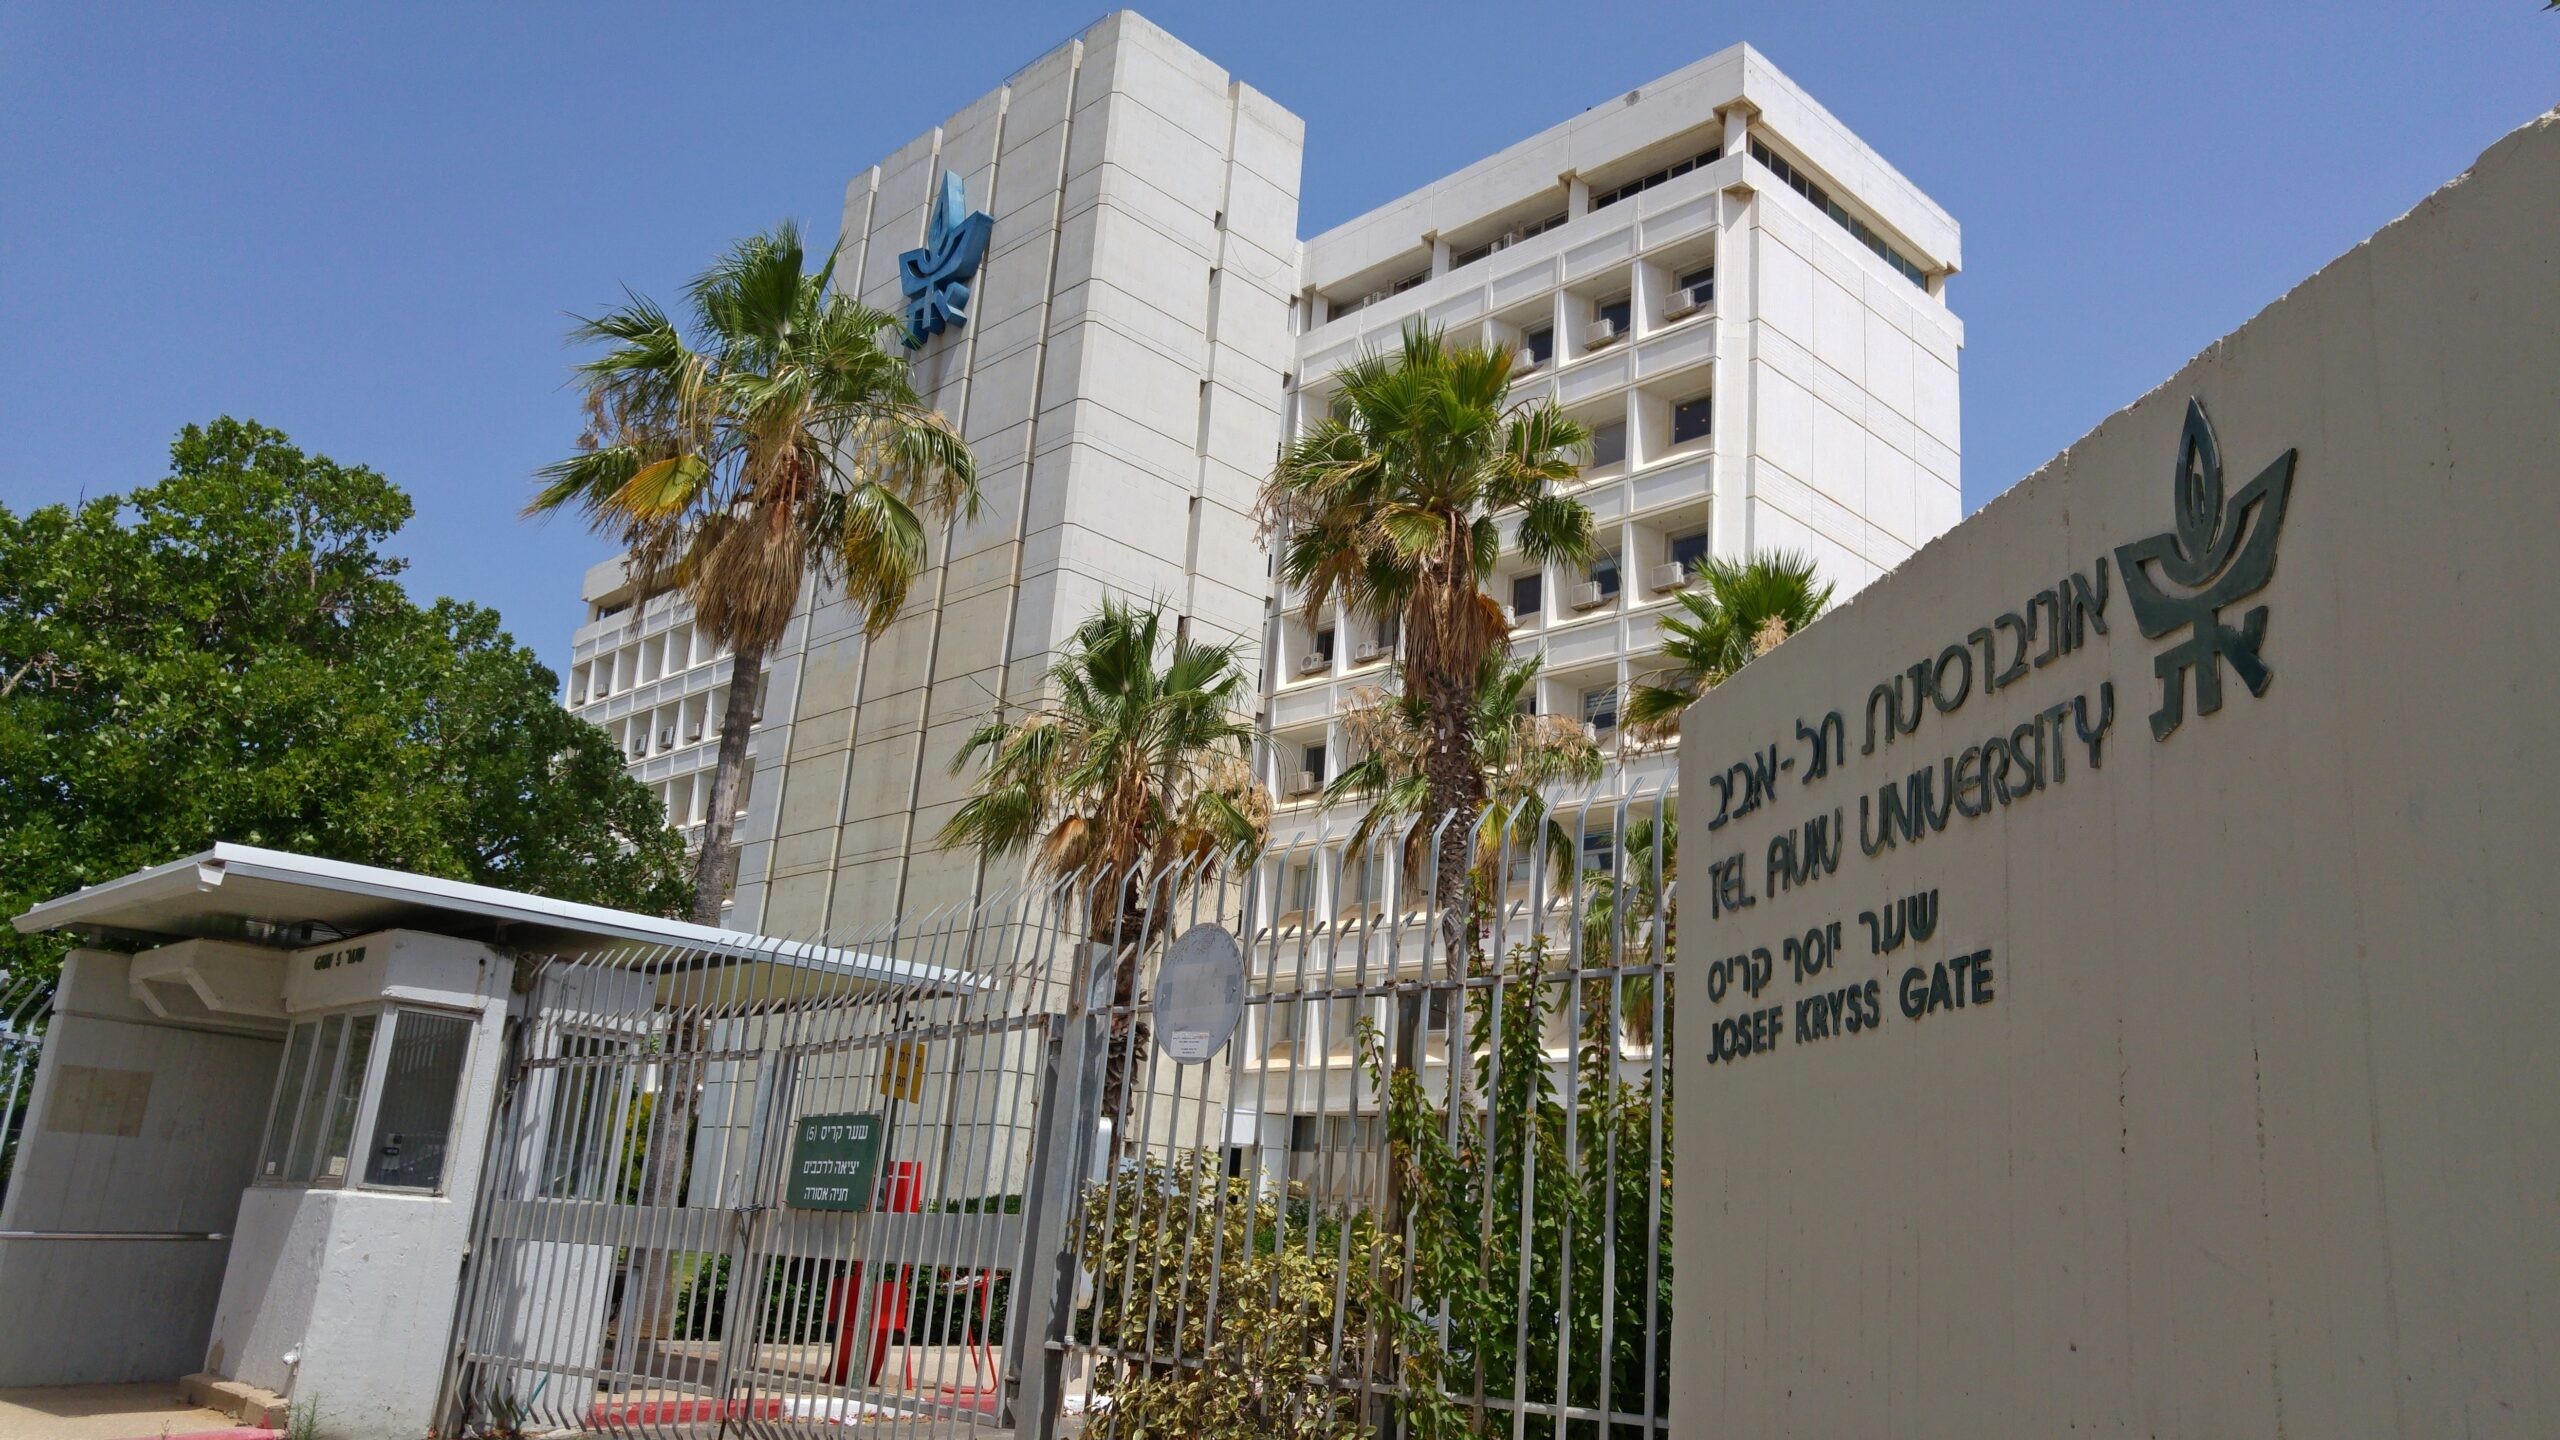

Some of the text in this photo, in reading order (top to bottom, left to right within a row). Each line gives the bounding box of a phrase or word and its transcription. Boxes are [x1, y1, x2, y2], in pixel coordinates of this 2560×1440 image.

[1708, 557, 2110, 831] אוניברסיטת תל-אביב
[1708, 681, 2114, 919] TEL AVIV UNIVERSITY
[1707, 888, 1939, 1003] שער יוסף קריס
[1706, 948, 1994, 1064] JOSEF KRYSS GATE
[803, 1159, 860, 1175] יציאה לרכבים
[806, 1125, 869, 1143] שער קריס (5)
[803, 1186, 849, 1202] חניה אסורה
